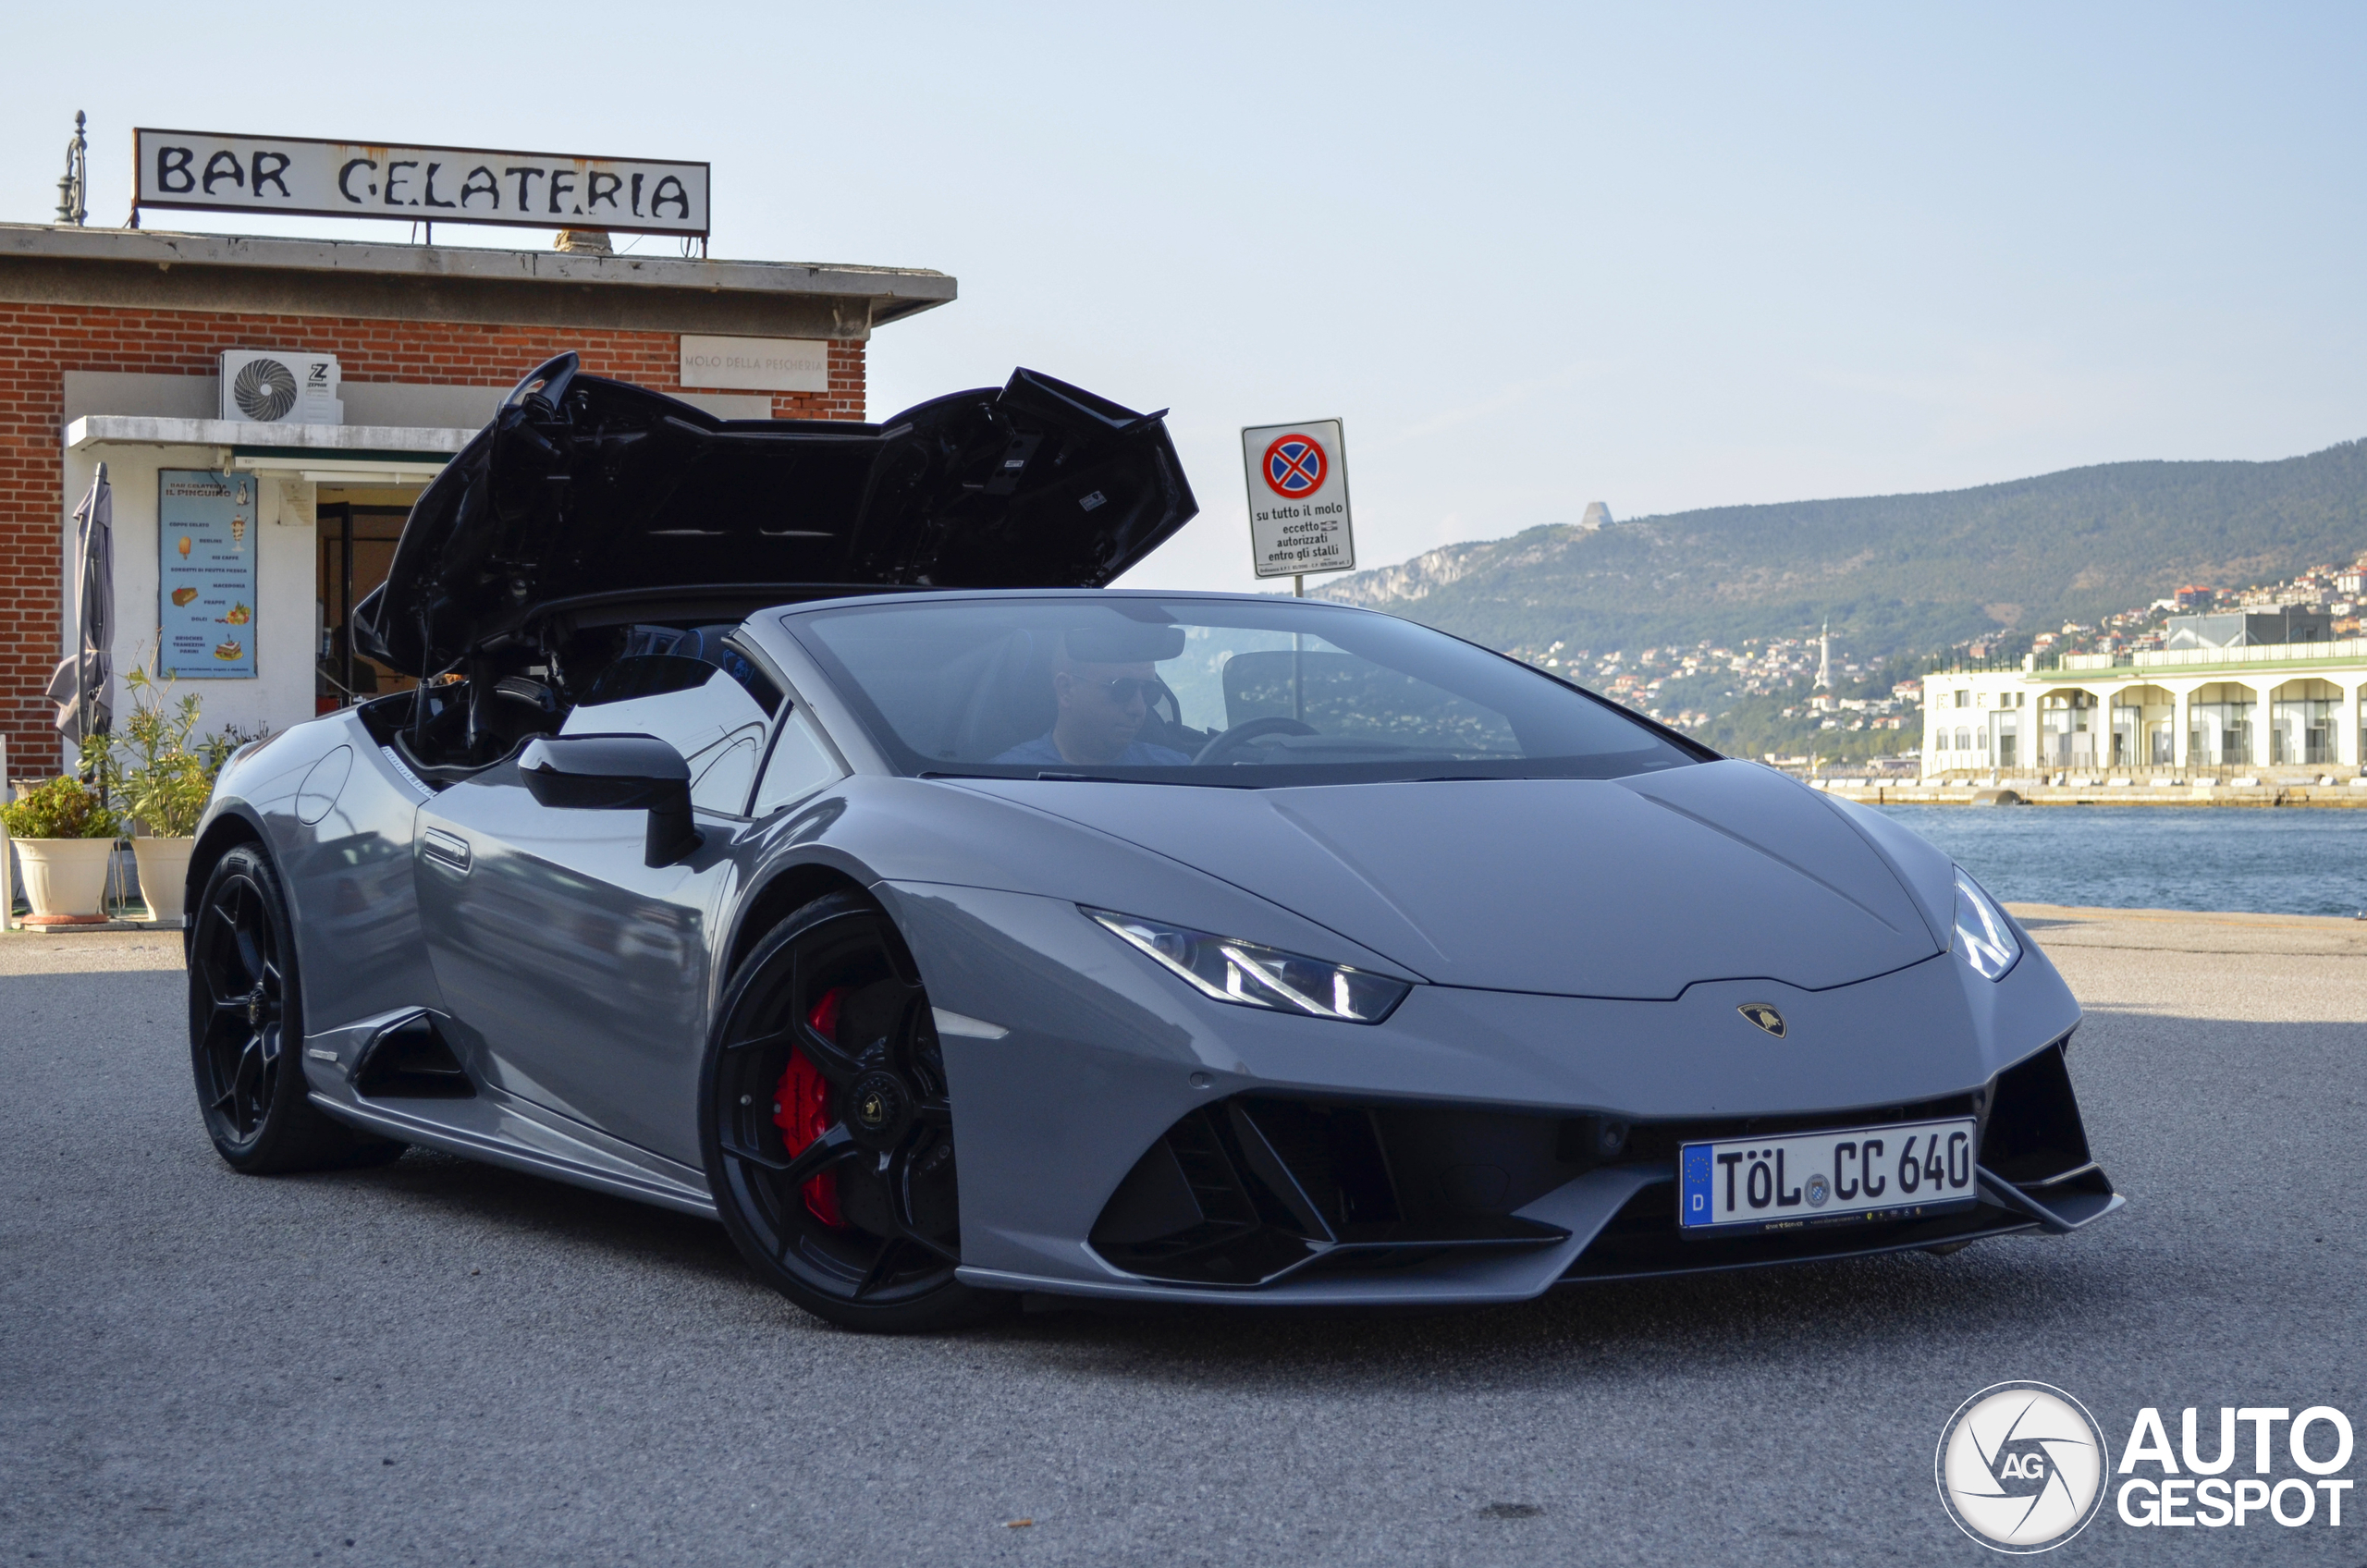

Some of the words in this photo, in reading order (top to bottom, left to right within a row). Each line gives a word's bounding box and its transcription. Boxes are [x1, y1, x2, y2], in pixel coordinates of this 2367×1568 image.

[156, 146, 291, 198] BAR
[337, 158, 691, 219] GELATERIA
[685, 356, 721, 368] MOLO
[727, 357, 761, 369] DELLA
[766, 359, 822, 371] PESCHERIA
[177, 489, 231, 497] PINGUINO
[1257, 511, 1269, 521] su
[1271, 506, 1299, 520] tutto
[1303, 504, 1311, 517] il
[1315, 502, 1343, 515] molo
[1282, 521, 1319, 533] eccetto
[1277, 533, 1328, 547] autorizzati
[1269, 550, 1294, 561] entro
[1296, 547, 1309, 561] gli
[1313, 545, 1339, 557] stalli
[1717, 1147, 1802, 1212] TÖL
[1834, 1139, 1886, 1201] CC
[1898, 1131, 1969, 1194] 640
[1693, 1194, 1704, 1211] D
